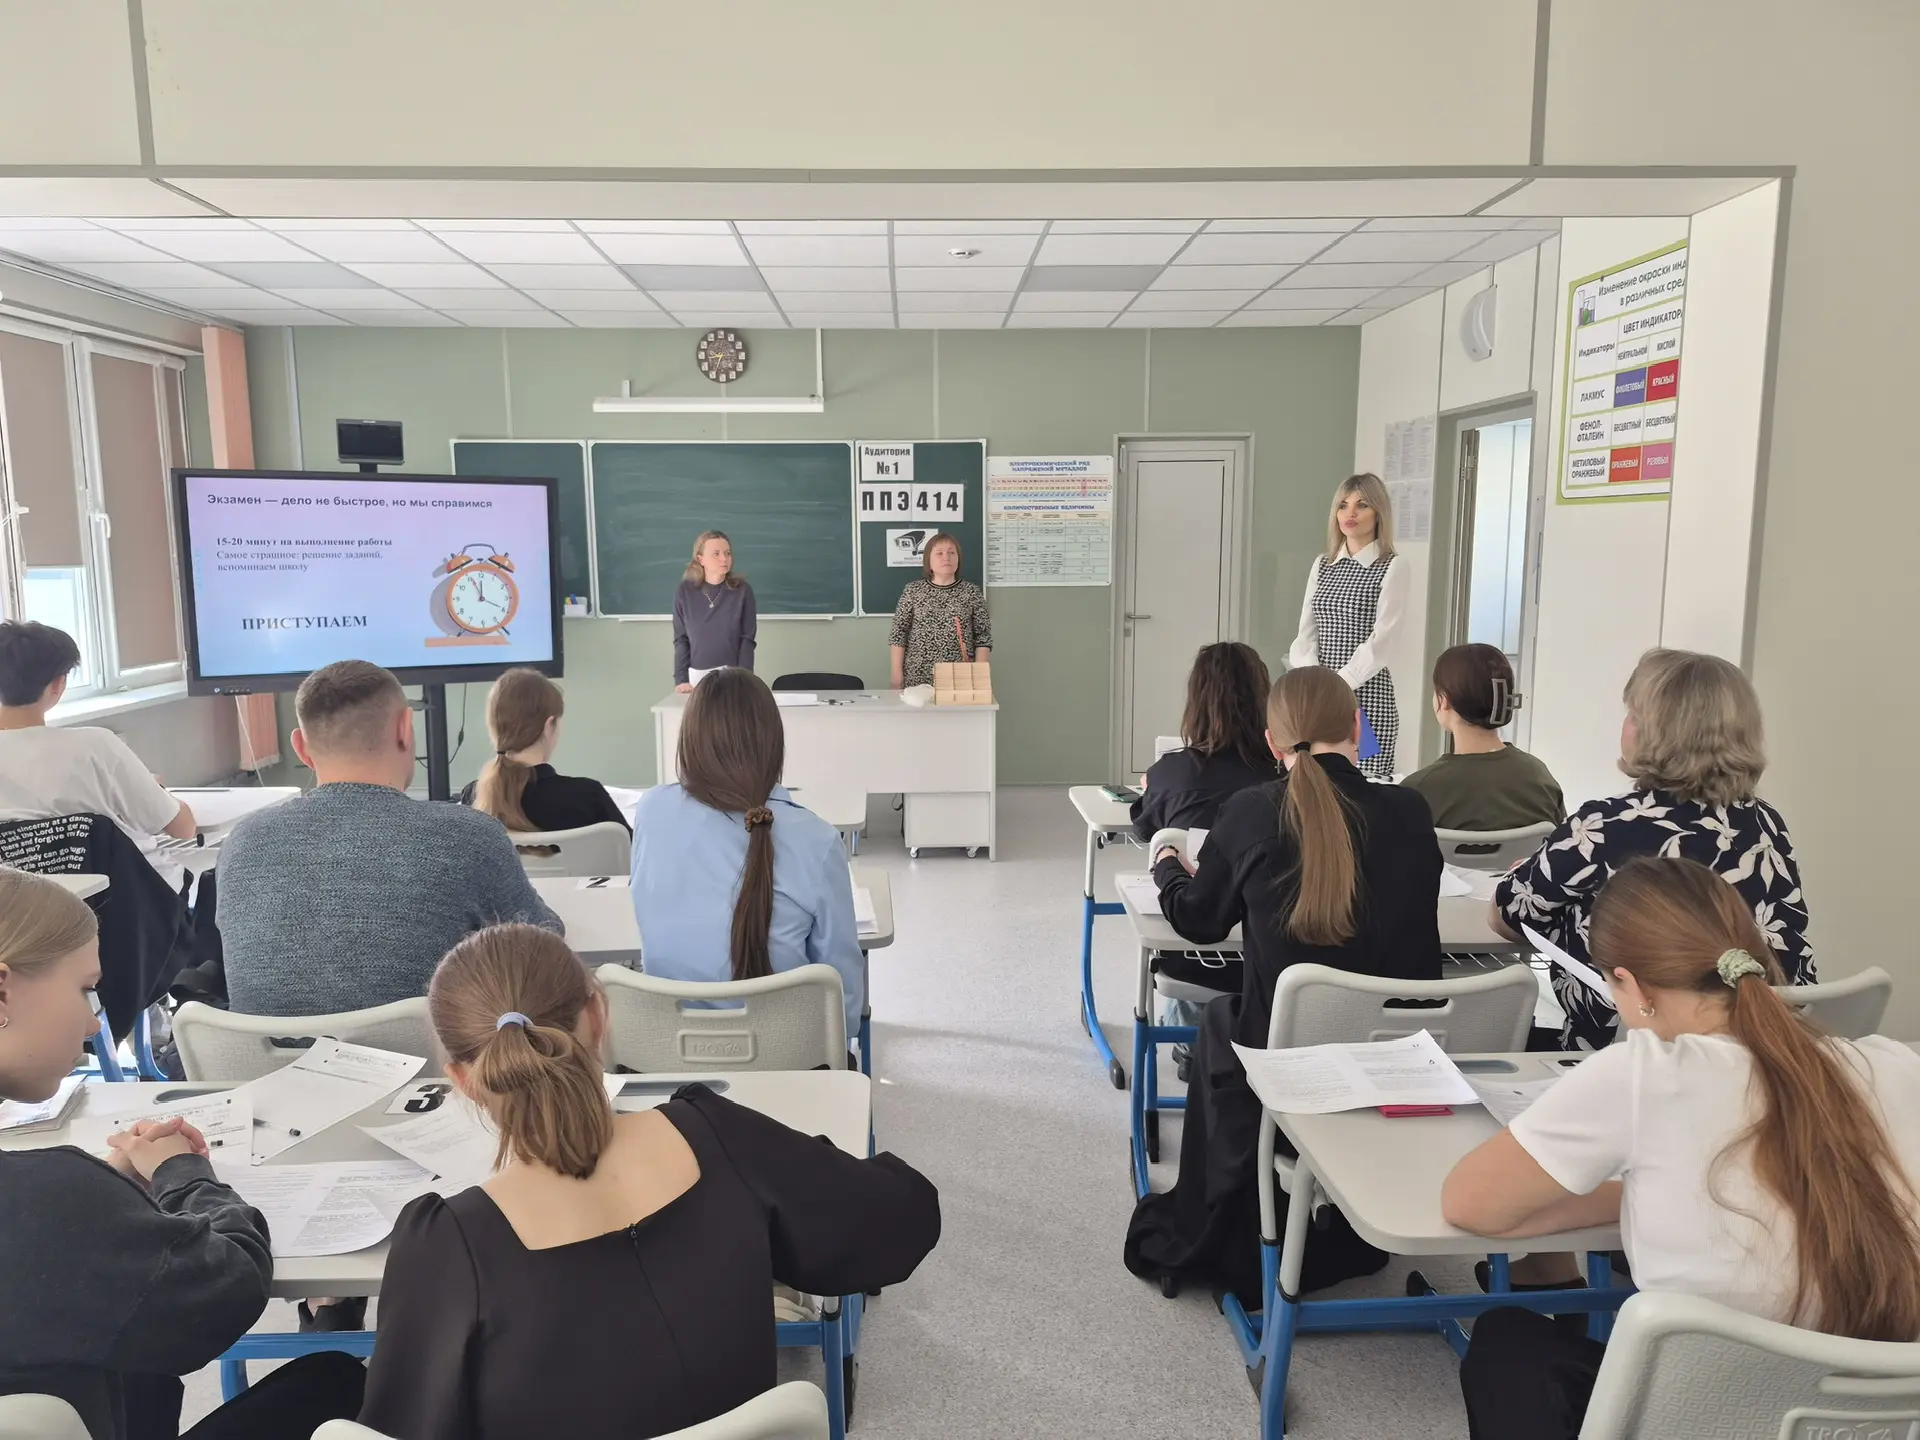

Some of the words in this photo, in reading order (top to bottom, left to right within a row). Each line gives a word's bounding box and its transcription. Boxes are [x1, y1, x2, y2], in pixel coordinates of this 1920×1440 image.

[1598, 277, 1637, 296] Изменение
[1638, 265, 1671, 283] окраски
[1620, 297, 1624, 306] в
[1625, 284, 1665, 306] различных
[1623, 320, 1639, 333] ЦВЕТ
[1579, 343, 1615, 357] Индикаторы
[1657, 338, 1676, 351] КИСЛОЙ
[1616, 379, 1645, 394] ФИОЛЕТОВЫЙ
[1652, 373, 1674, 387] КРАСНЫЙ
[1580, 389, 1605, 402] ЛАКМУС
[1580, 420, 1602, 431] ФЕНОЛ-
[1614, 419, 1641, 432] БЕСЦВЕТНЫЙ
[1577, 431, 1604, 442] ФТАЛЕИН
[864, 447, 910, 456] Аудитория
[877, 461, 890, 475] №
[892, 461, 898, 475] 1
[1572, 456, 1605, 468] МЕТИЛОВЫЙ
[1612, 458, 1638, 469] ОРАНЖЕВЫЙ
[1572, 467, 1605, 478] ОРАНЖЕВЫЙ
[207, 494, 261, 504] Экзамен
[281, 497, 312, 506] дело
[333, 497, 389, 508] быстрое,
[392, 499, 407, 507] но
[410, 499, 428, 507] мы
[431, 499, 493, 510] справимся
[862, 491, 909, 511] ППЭ
[916, 491, 959, 511] 414
[216, 537, 243, 546] 15-20
[246, 539, 276, 548] минут
[358, 537, 392, 547] работы
[216, 550, 248, 559] Самое
[250, 551, 300, 561] страшное:
[302, 552, 342, 561] решение
[218, 564, 276, 572] вспоминаем
[279, 564, 309, 573] школу
[242, 615, 367, 630] ПРИСТУПАЕМ
[34, 827, 53, 836] Lord
[34, 833, 65, 844] forgive
[76, 830, 89, 838] for
[5, 848, 25, 858] Could
[59, 848, 69, 856] go
[47, 864, 66, 873] time
[586, 877, 611, 888] 2
[404, 1084, 454, 1113] 3
